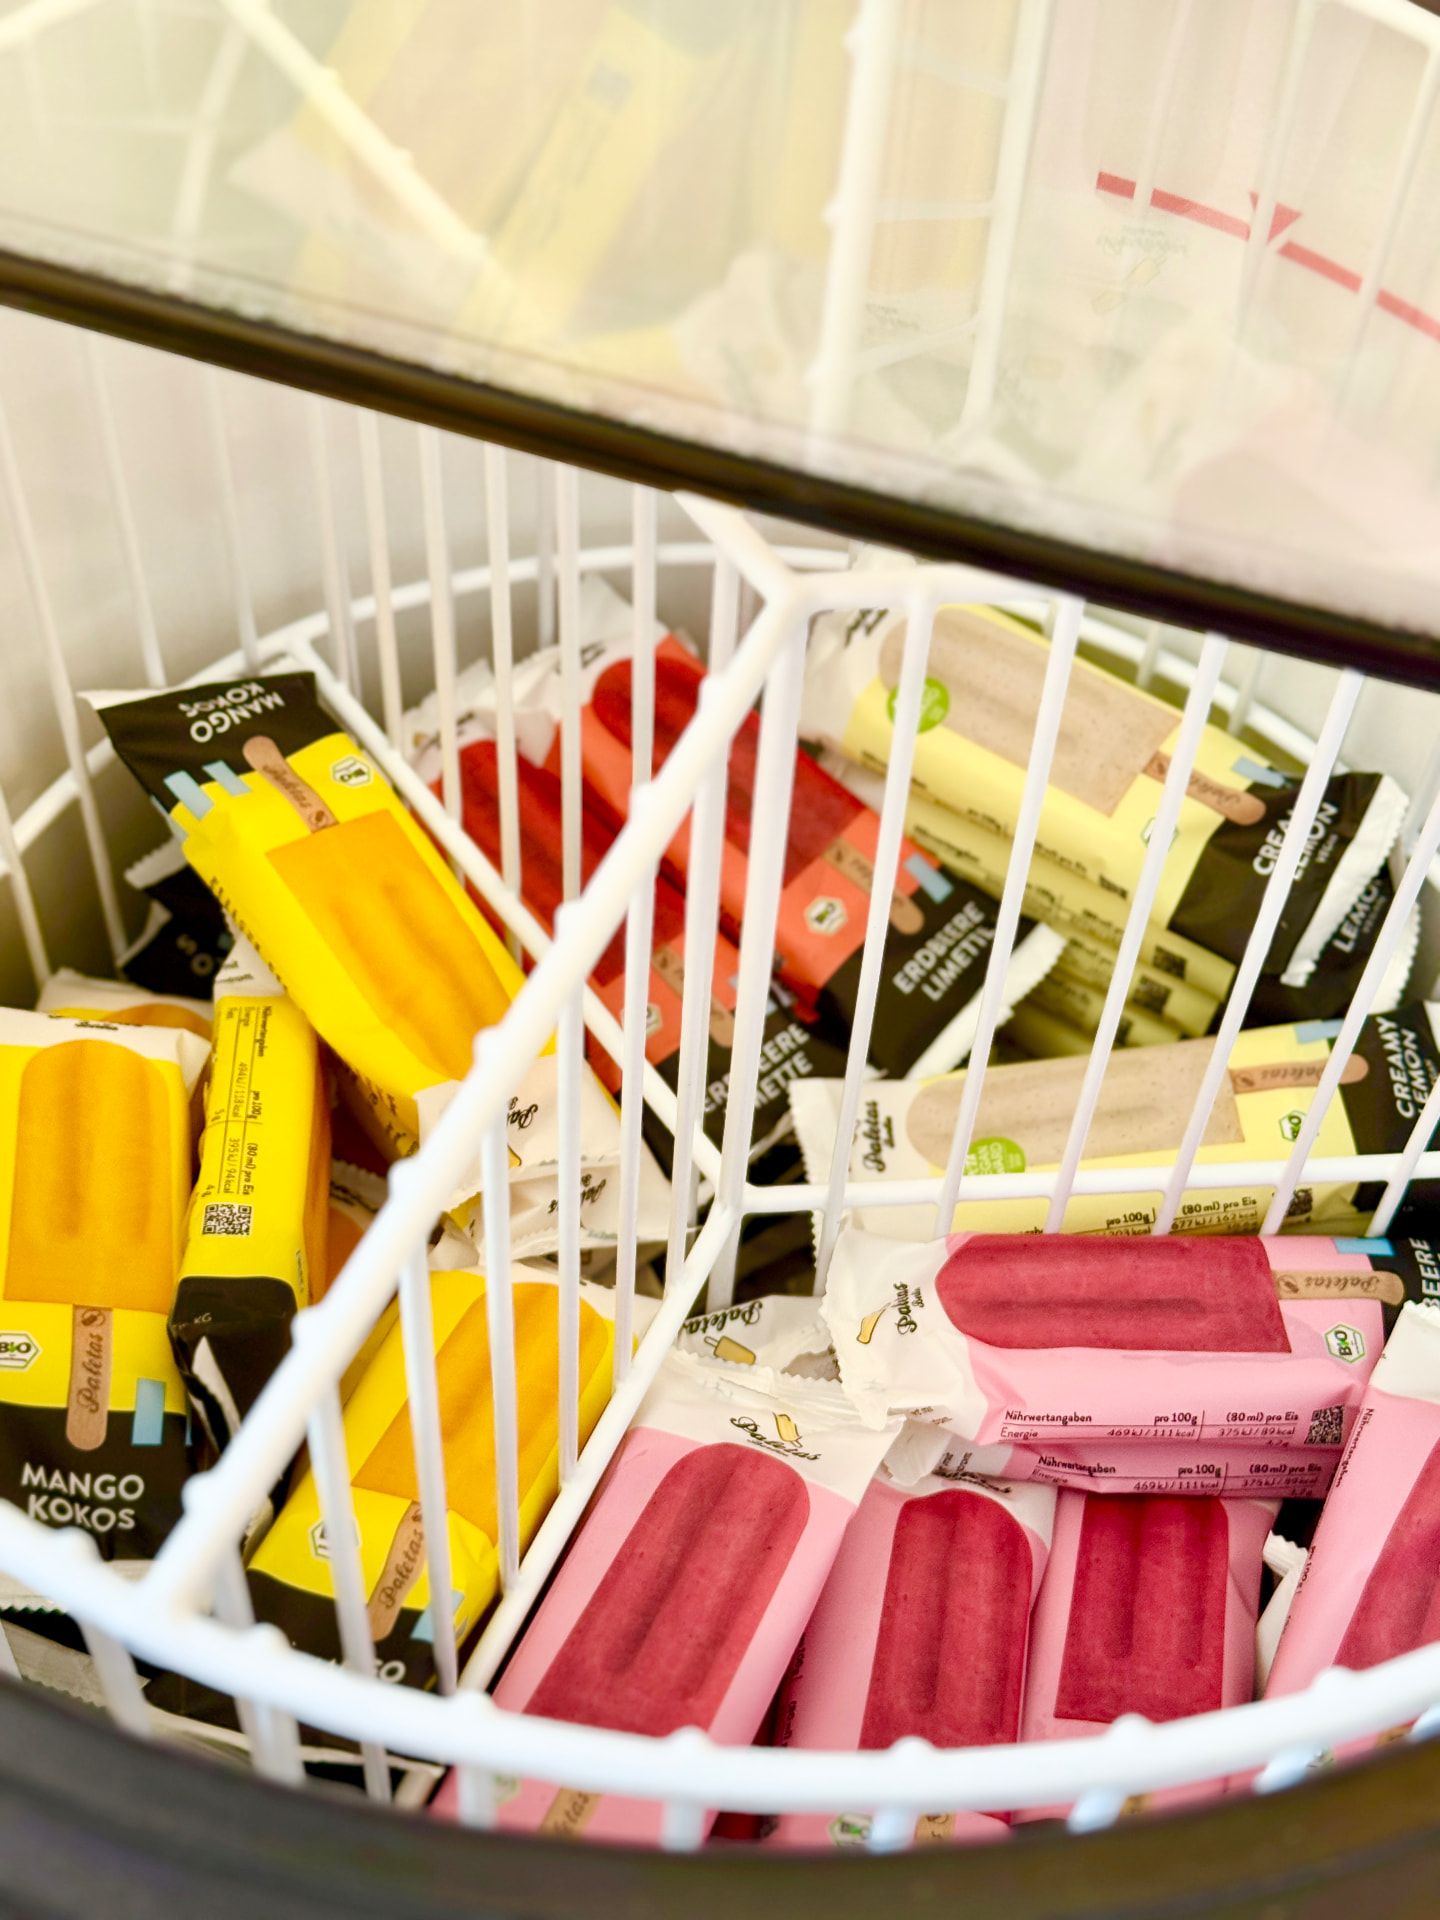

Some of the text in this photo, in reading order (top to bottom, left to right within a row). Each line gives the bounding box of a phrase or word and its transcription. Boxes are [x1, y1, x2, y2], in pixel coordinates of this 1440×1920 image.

[178, 681, 265, 718] KOKOS
[189, 692, 286, 743] MANGO
[1332, 879, 1384, 954] LEMO
[892, 901, 986, 995] ERDBEERE
[1376, 1016, 1416, 1119] CREAMY
[1399, 1027, 1430, 1112] EMON
[1106, 1216, 1121, 1228] pro
[1223, 1202, 1239, 1213] pro
[1241, 1197, 1257, 1207] Eis
[1303, 1275, 1381, 1294] Paletas
[682, 1300, 764, 1335] Paleta
[1334, 1330, 1353, 1357] BIO
[76, 1332, 104, 1414] Paletas
[1000, 1426, 1039, 1441] Energie
[1004, 1409, 1092, 1426] Nährwertangaben
[1153, 1414, 1169, 1427] pro
[1171, 1412, 1198, 1426] 100g
[1266, 1414, 1283, 1425] pro
[1284, 1410, 1299, 1421] Eis
[1037, 1455, 1117, 1477] Nährwertangaben
[1178, 1466, 1193, 1479] pro
[1335, 1407, 1375, 1488] Nährwertangaben
[20, 1461, 146, 1502] MANGO
[26, 1492, 136, 1534] KOKOS
